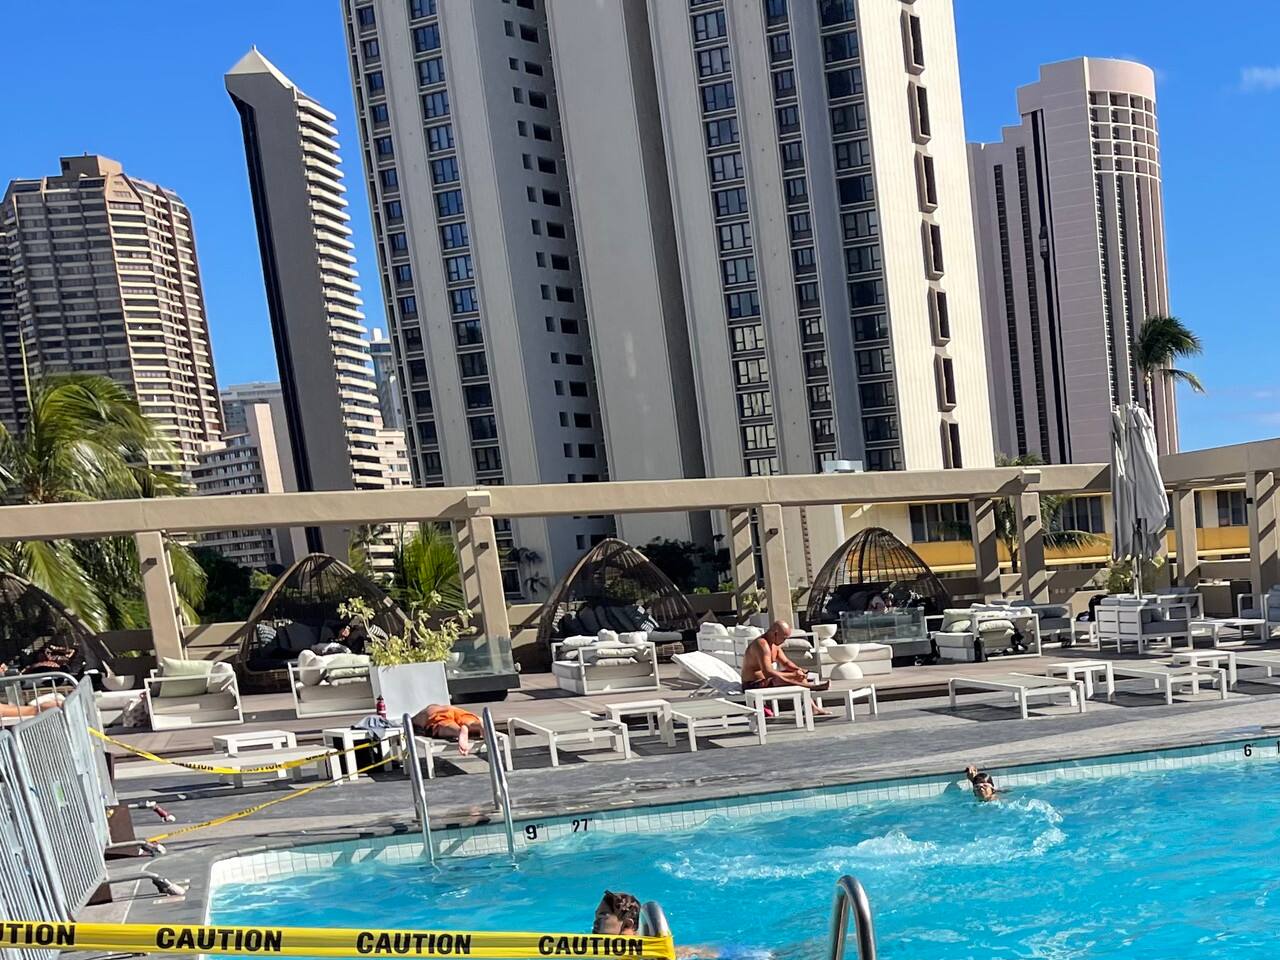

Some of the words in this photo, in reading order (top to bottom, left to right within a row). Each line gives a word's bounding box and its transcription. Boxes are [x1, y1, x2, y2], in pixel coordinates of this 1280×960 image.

[156, 927, 282, 952] CAUTION
[356, 931, 471, 955] CAUTION
[538, 936, 643, 956] CAUTION
